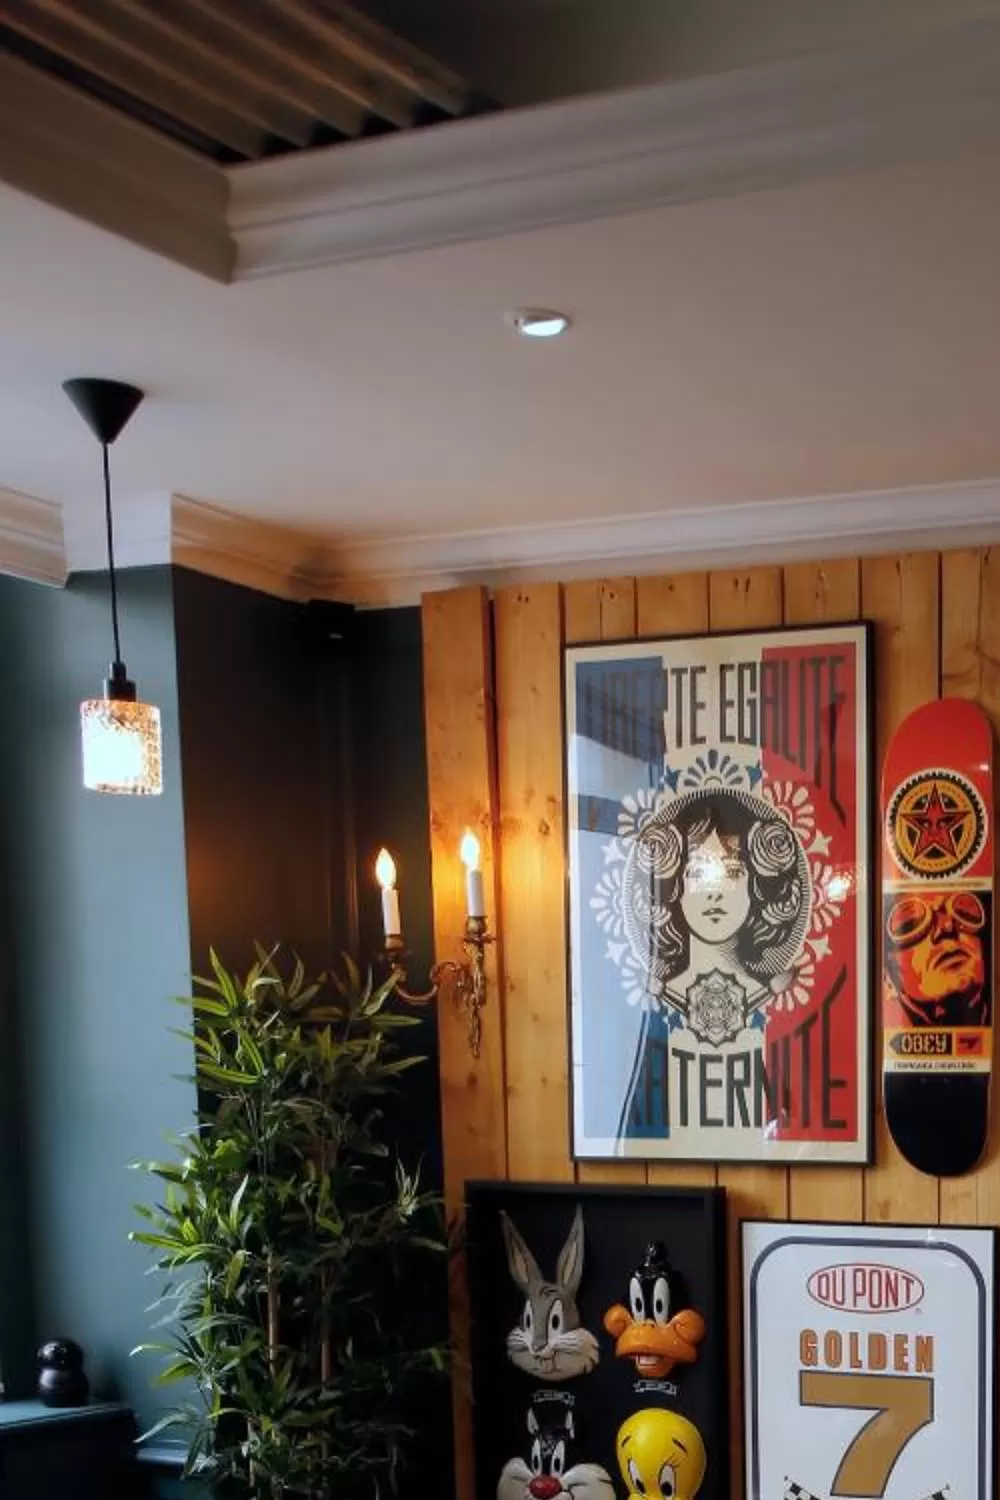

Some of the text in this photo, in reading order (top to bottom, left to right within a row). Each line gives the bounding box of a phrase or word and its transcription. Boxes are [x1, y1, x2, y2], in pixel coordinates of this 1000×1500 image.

[901, 1033, 947, 1053] OBEY
[817, 1267, 915, 1309] DU PONT
[799, 1328, 934, 1373] GOLDEN
[799, 1369, 935, 1499] 7
